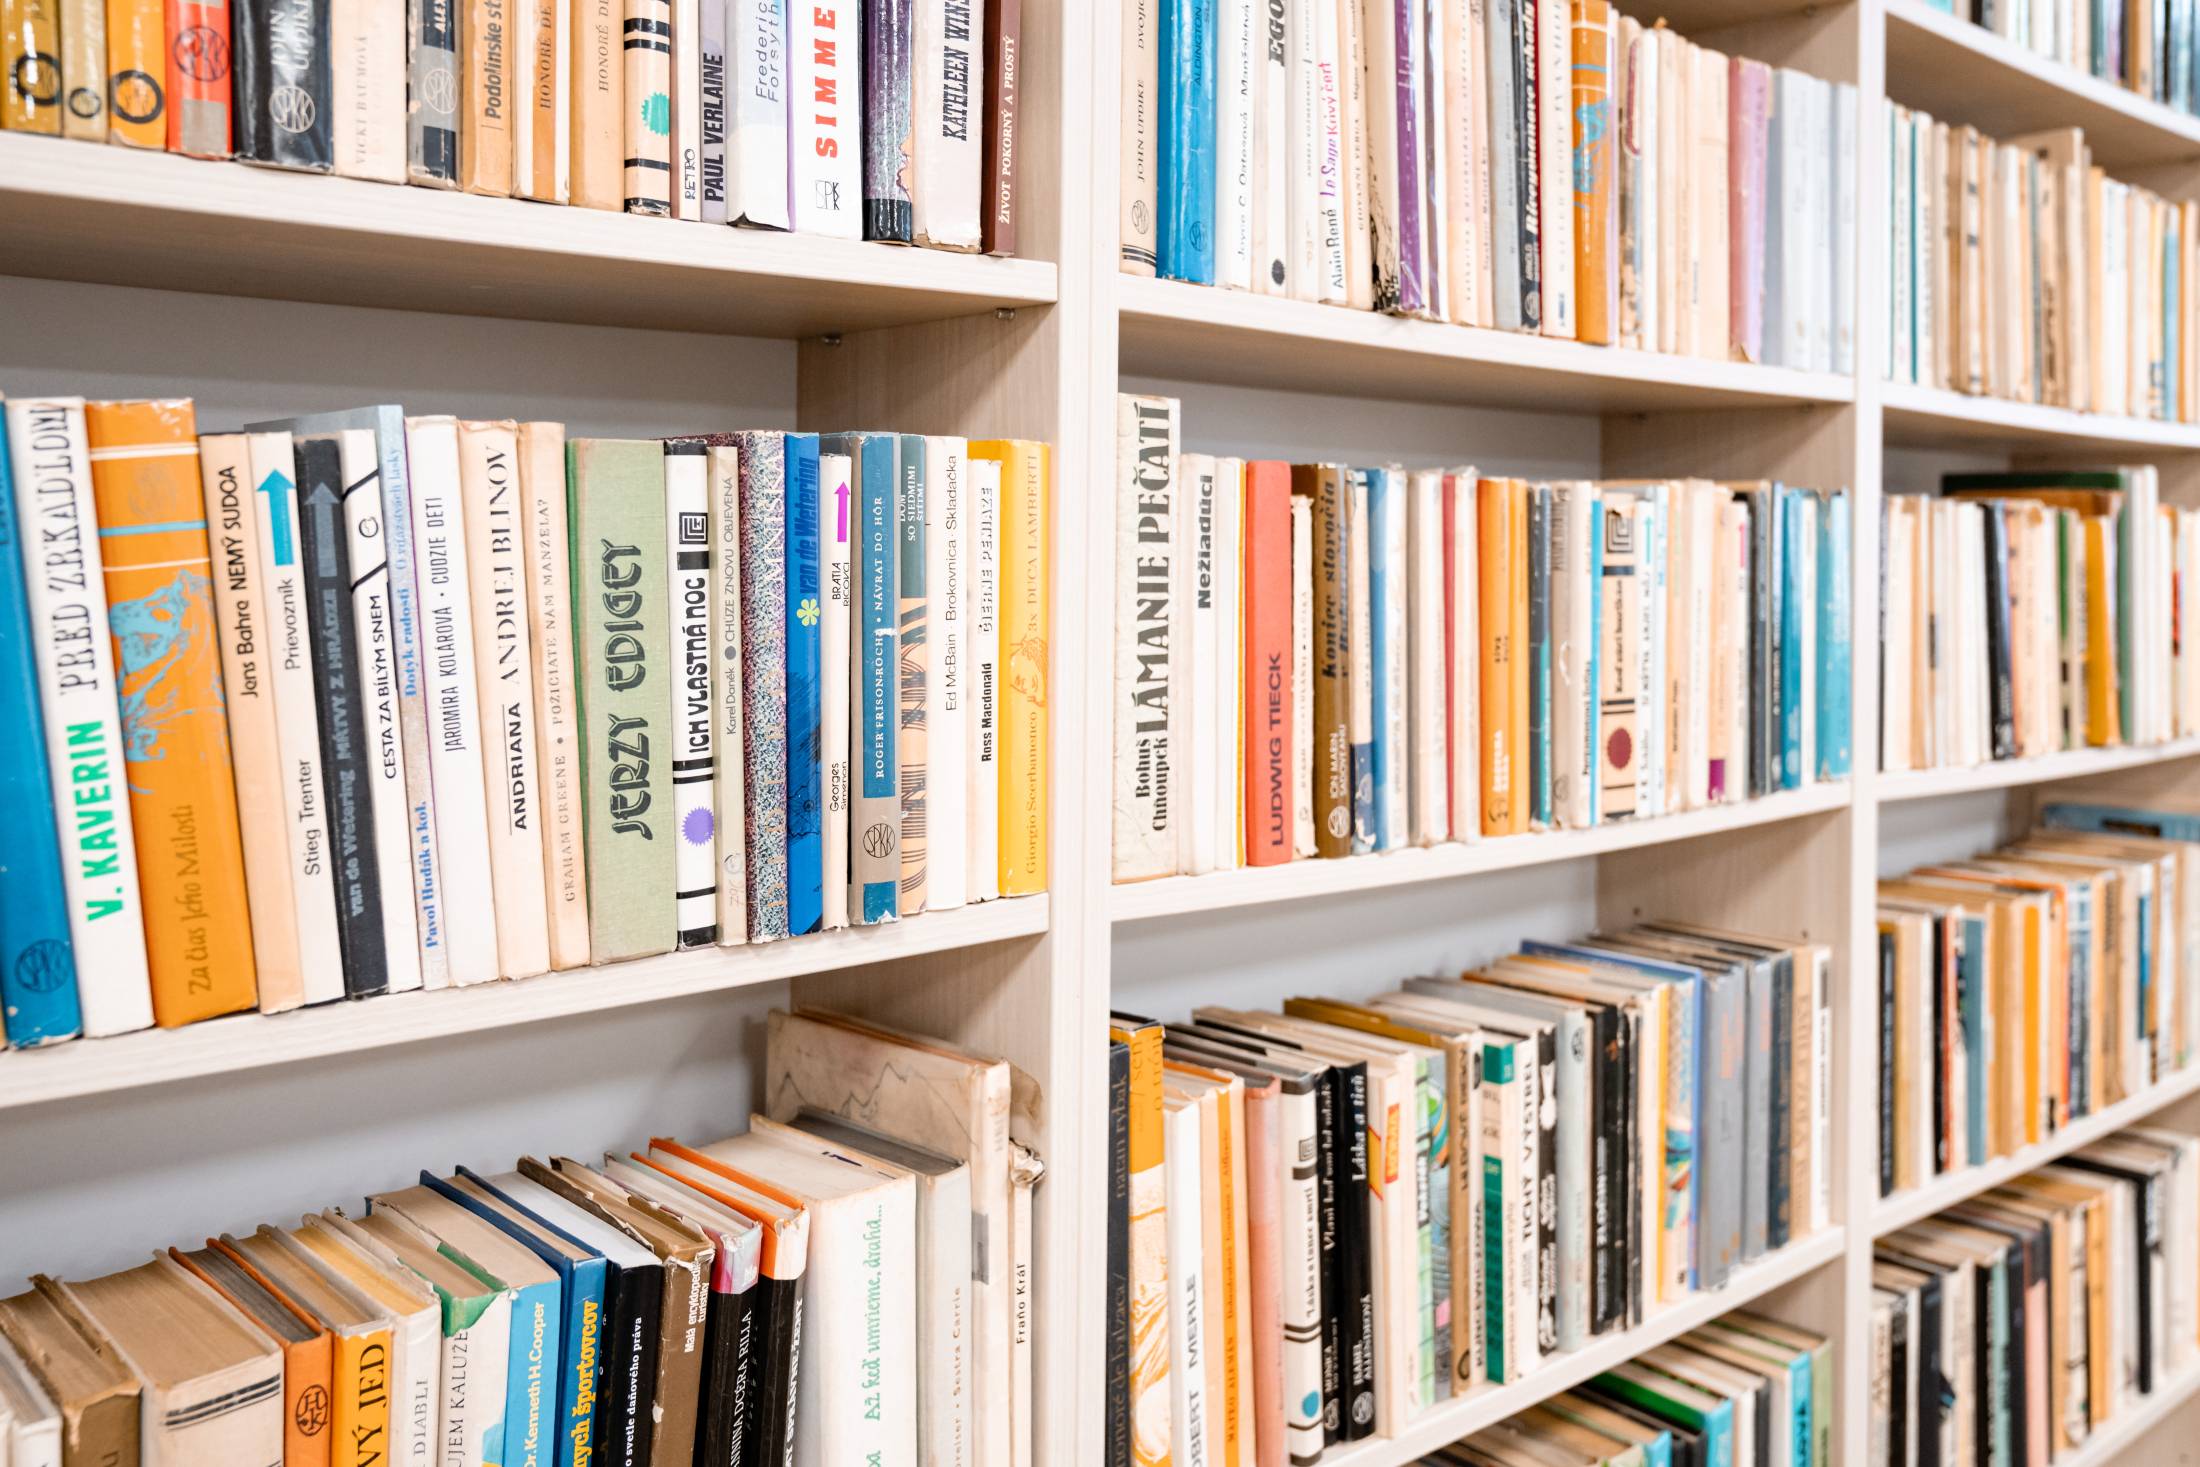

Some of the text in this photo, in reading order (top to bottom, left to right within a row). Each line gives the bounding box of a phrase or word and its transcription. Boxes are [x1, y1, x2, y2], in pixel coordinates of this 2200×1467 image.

[595, 22, 610, 91] HONORÉ
[814, 4, 838, 158] SIMME
[1193, 4, 1205, 85] ALDINGTON
[702, 50, 725, 201] PAUL VERLAINE
[942, 43, 970, 141] KATHLEEN
[1320, 94, 1339, 136] Krivý
[998, 33, 1016, 225] ŽIVOT POKORNÝ A PROSTÝ
[1136, 77, 1147, 182] JOHN UPDIKE
[1319, 136, 1339, 175] Sage
[683, 147, 697, 199] RETRO
[1320, 206, 1340, 248] René
[1328, 248, 1345, 288] Alain
[792, 456, 819, 594] van de Wetering
[870, 495, 884, 527] HÔR
[907, 464, 916, 542] SO SIEDMIMI
[980, 487, 993, 563] PENIAZE
[873, 531, 884, 553] DO
[1131, 400, 1171, 735] LÁMANIE PEČATÍ
[1196, 474, 1215, 610] Nežiadúci
[684, 577, 706, 620] NOC
[719, 476, 737, 736] Karel Daněk CHŮZE ZNOVU OBJEVENÁ
[831, 561, 842, 601] BRATIA
[871, 560, 884, 612] NÁVRAT
[943, 455, 958, 712] Ed McBain Brokovnica Skladačka
[1025, 557, 1039, 606] DUCA
[1318, 479, 1338, 680] Koniec storočia
[219, 534, 261, 700] Jens Bahre NEMÝ
[319, 588, 344, 670] HRÁDZE
[424, 497, 467, 753] JAROMÍRA KOLÁROVÁ CUDZIE DETI
[491, 563, 521, 685] ANDREJ
[330, 674, 346, 690] Z
[367, 594, 397, 780] CESTA ZA BÍLÝM SNEM
[599, 537, 654, 841] JERZY EDIGEY
[981, 662, 994, 730] Macdonald
[41, 602, 124, 923] V. KAVERIN PRED
[274, 577, 326, 877] Stieg Trenter Prievozník
[687, 719, 709, 755] ICH
[873, 731, 886, 778] ROGER
[981, 731, 993, 763] Ross
[1267, 653, 1285, 847] LUDWIG TIECK
[396, 588, 441, 949] Pavol Hudák a kol. Dotyk radosti
[508, 701, 529, 832] ANDRIANA
[553, 755, 571, 825] GREENE
[827, 762, 842, 813] Georges
[839, 761, 849, 811] Simenon
[1133, 738, 1152, 800] Bohuš
[1151, 736, 1170, 832] Chňoupek
[170, 803, 201, 878] Milosti
[337, 769, 361, 856] Wetering
[1023, 814, 1041, 876] Giorgio
[559, 830, 577, 903] GRAHAM
[187, 965, 214, 996] Za
[1111, 1073, 1130, 1134] rybak
[1355, 1112, 1366, 1124] a
[1112, 1139, 1127, 1199] natan
[1351, 1131, 1368, 1182] Láska
[630, 1317, 643, 1352] práva
[683, 1327, 697, 1353] Malá
[1015, 1262, 1027, 1345] Fraňo Kráľ
[1186, 1272, 1199, 1369] MERLE
[358, 1343, 388, 1411] JED
[571, 1299, 599, 1417] športovcov
[625, 1354, 640, 1415] daňového
[734, 1308, 753, 1413] DCÉRA RILLA
[1109, 1364, 1127, 1389] de
[412, 1377, 429, 1457] DIABLI
[624, 1417, 637, 1456] svetle
